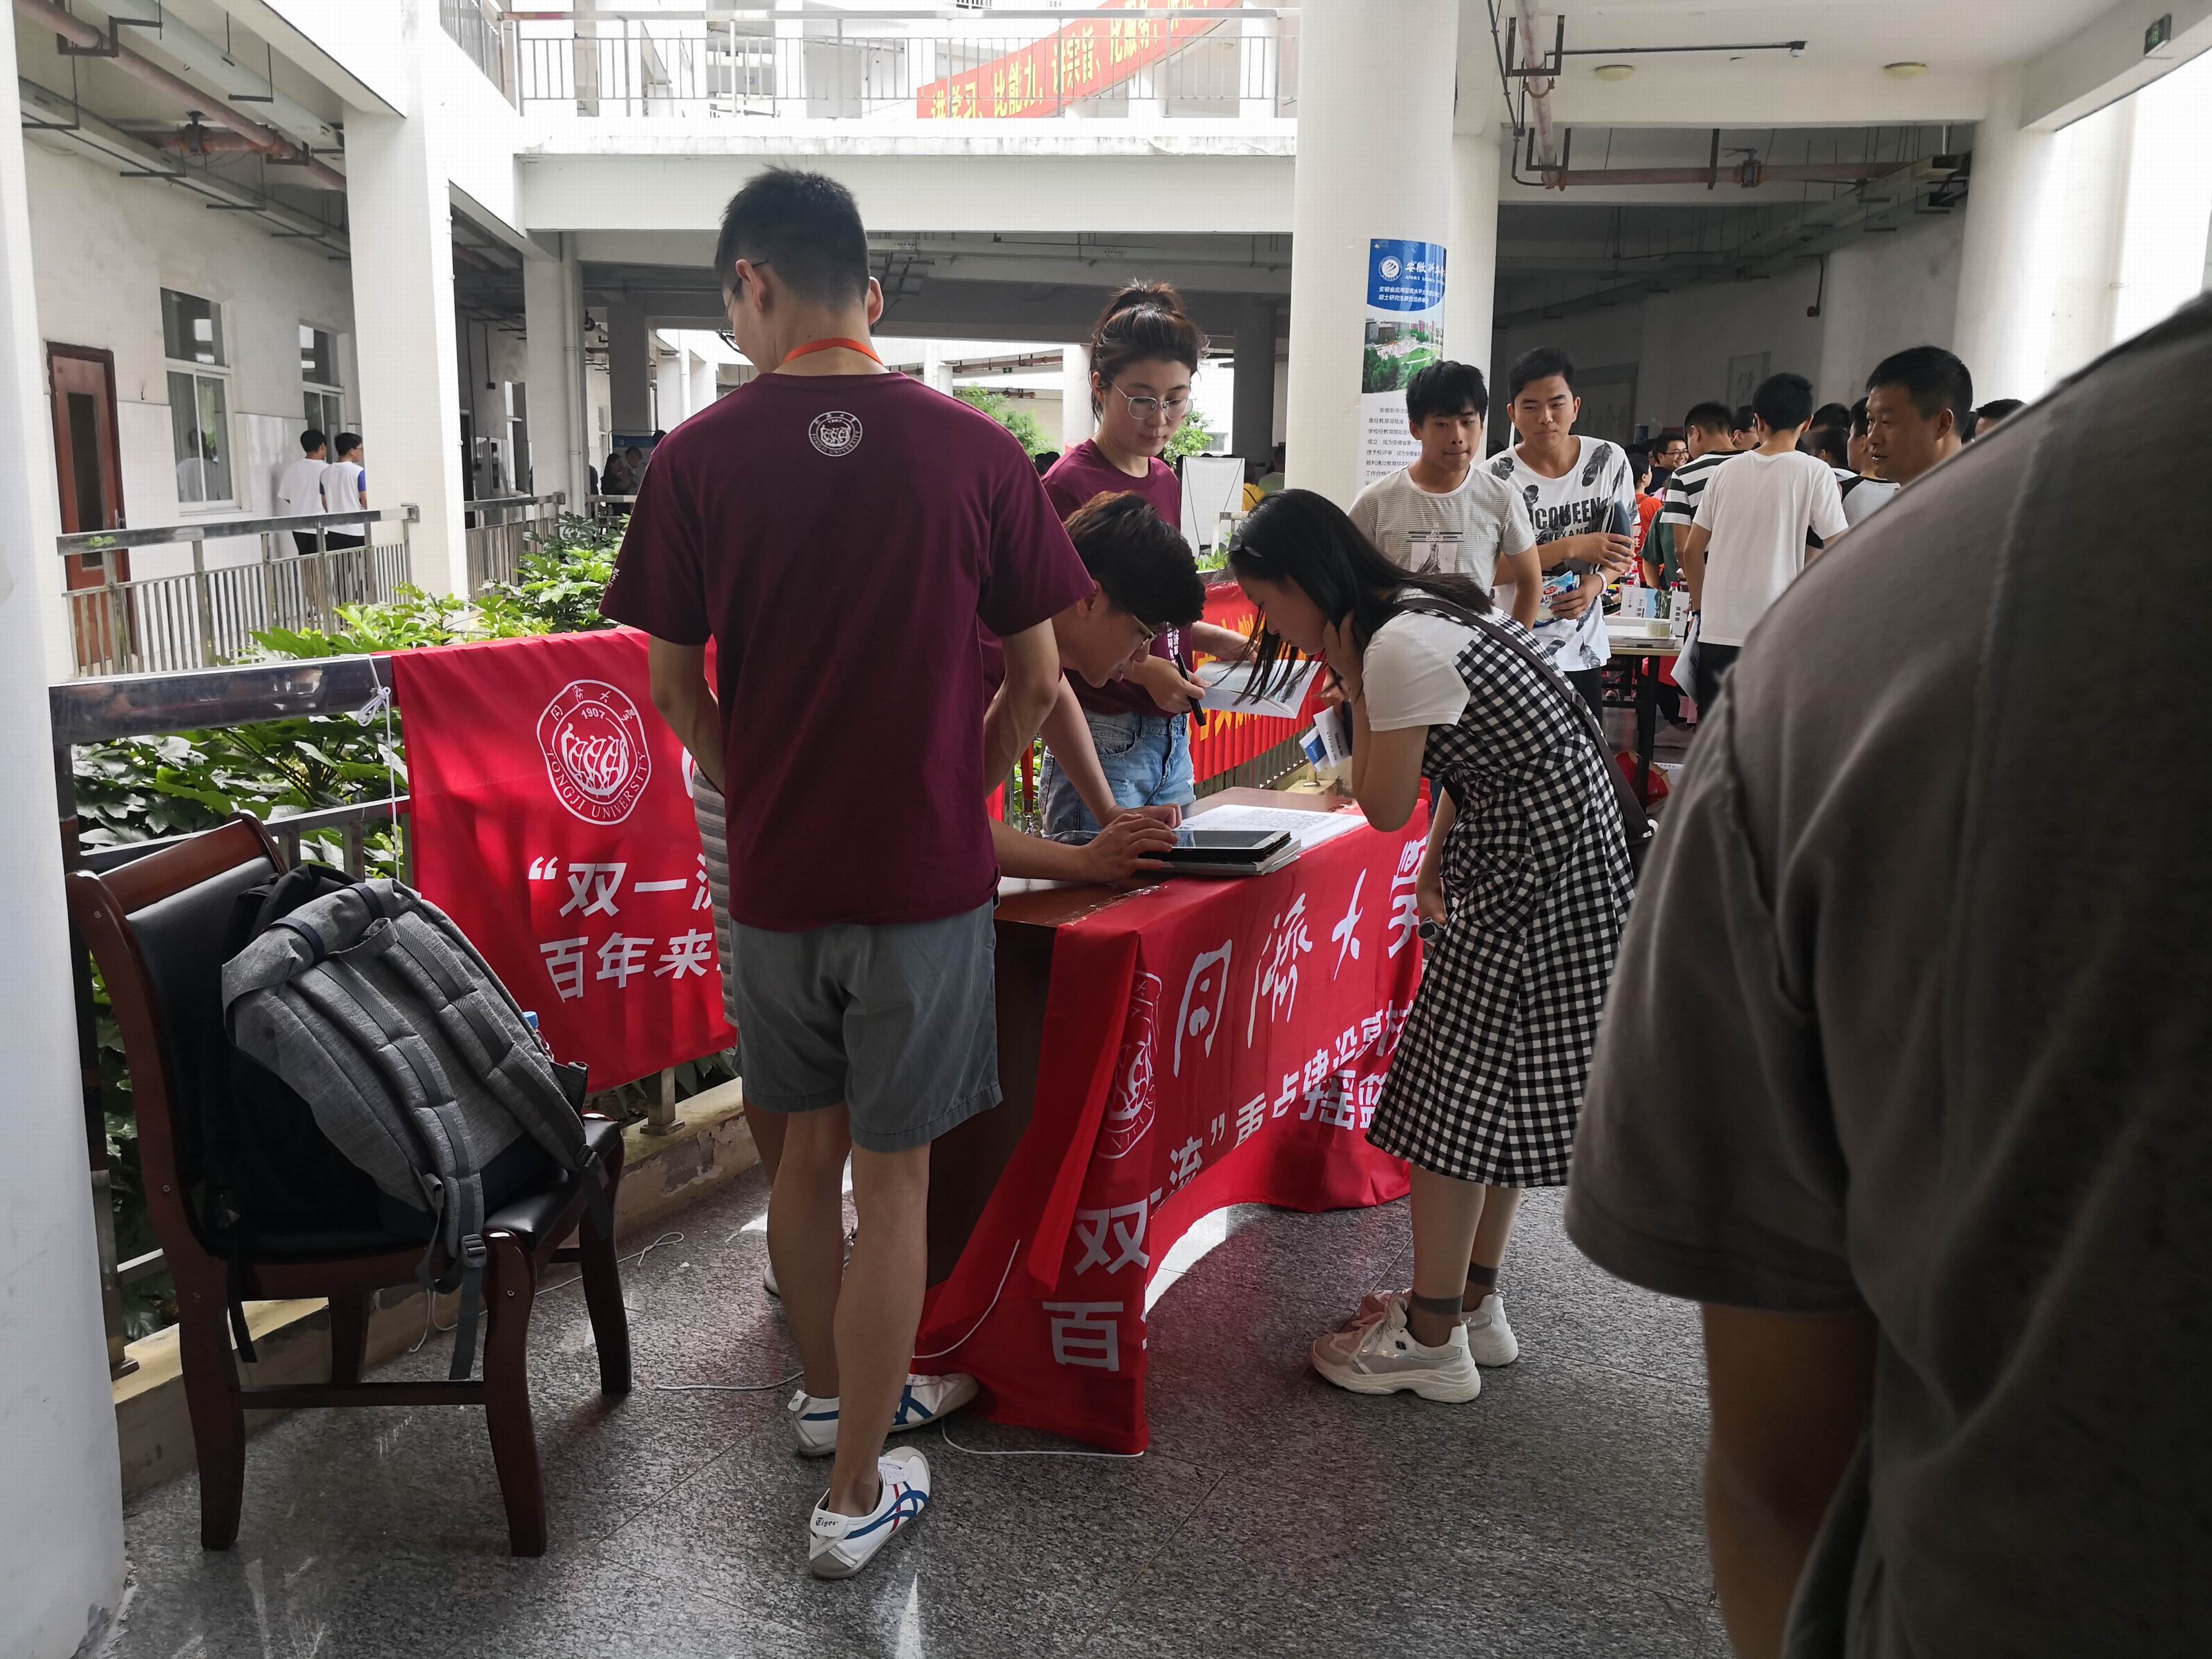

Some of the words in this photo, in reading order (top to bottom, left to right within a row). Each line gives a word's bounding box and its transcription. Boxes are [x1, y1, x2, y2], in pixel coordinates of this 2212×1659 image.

[581, 707, 606, 719] 1907
[546, 749, 586, 811] TONGJI
[591, 750, 648, 818] UNIVERSITY
[540, 929, 720, 1003] 百年来
[816, 1517, 839, 1527] Tiger
